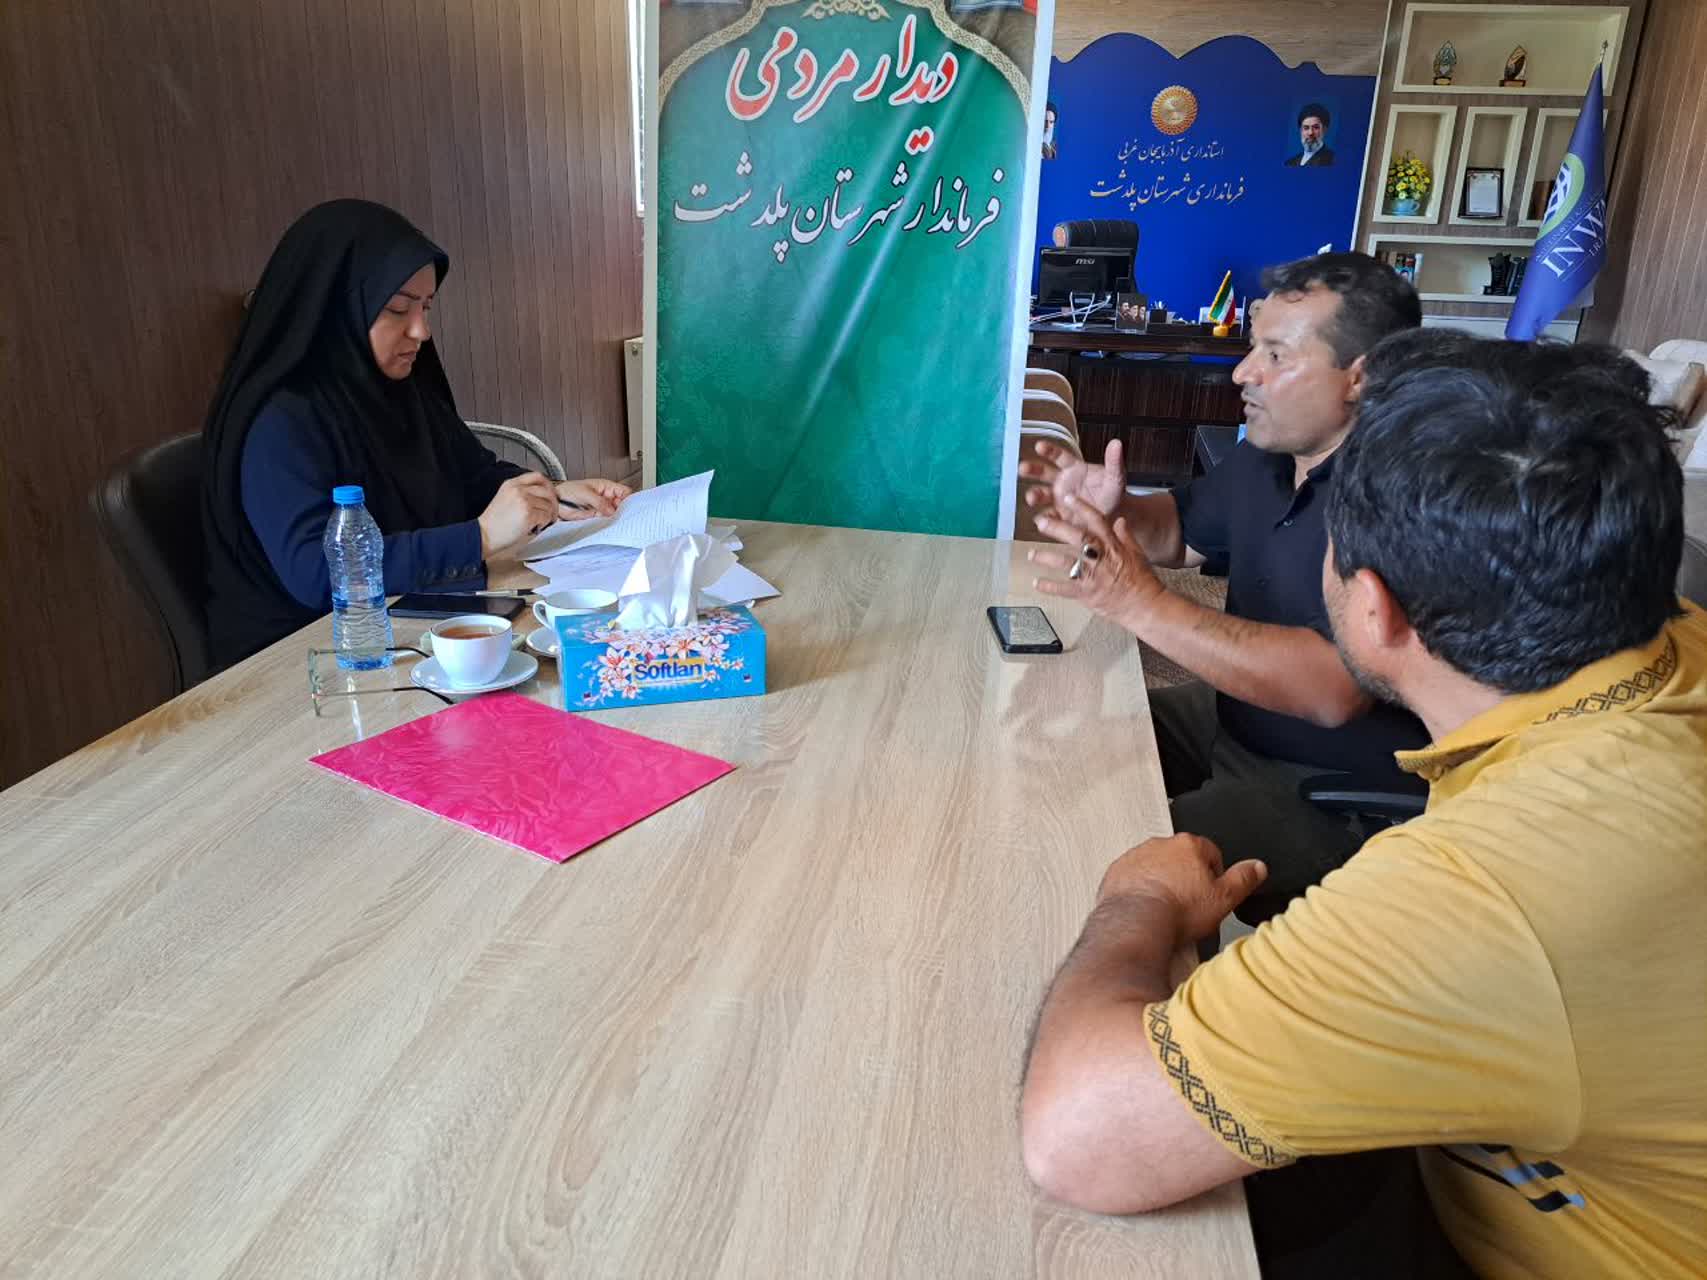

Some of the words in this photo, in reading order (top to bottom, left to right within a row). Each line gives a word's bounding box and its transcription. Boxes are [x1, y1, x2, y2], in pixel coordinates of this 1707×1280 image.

[725, 26, 859, 122] مردمی
[854, 14, 959, 155] دیدار
[1117, 138, 1139, 165] غربی
[1180, 140, 1225, 162] استانداری
[791, 161, 912, 246] شهرستان
[1137, 172, 1191, 204] شهرستان
[1186, 177, 1245, 205] فرمانداری
[904, 167, 1005, 249] فرماندار
[634, 661, 702, 681] Softlan
